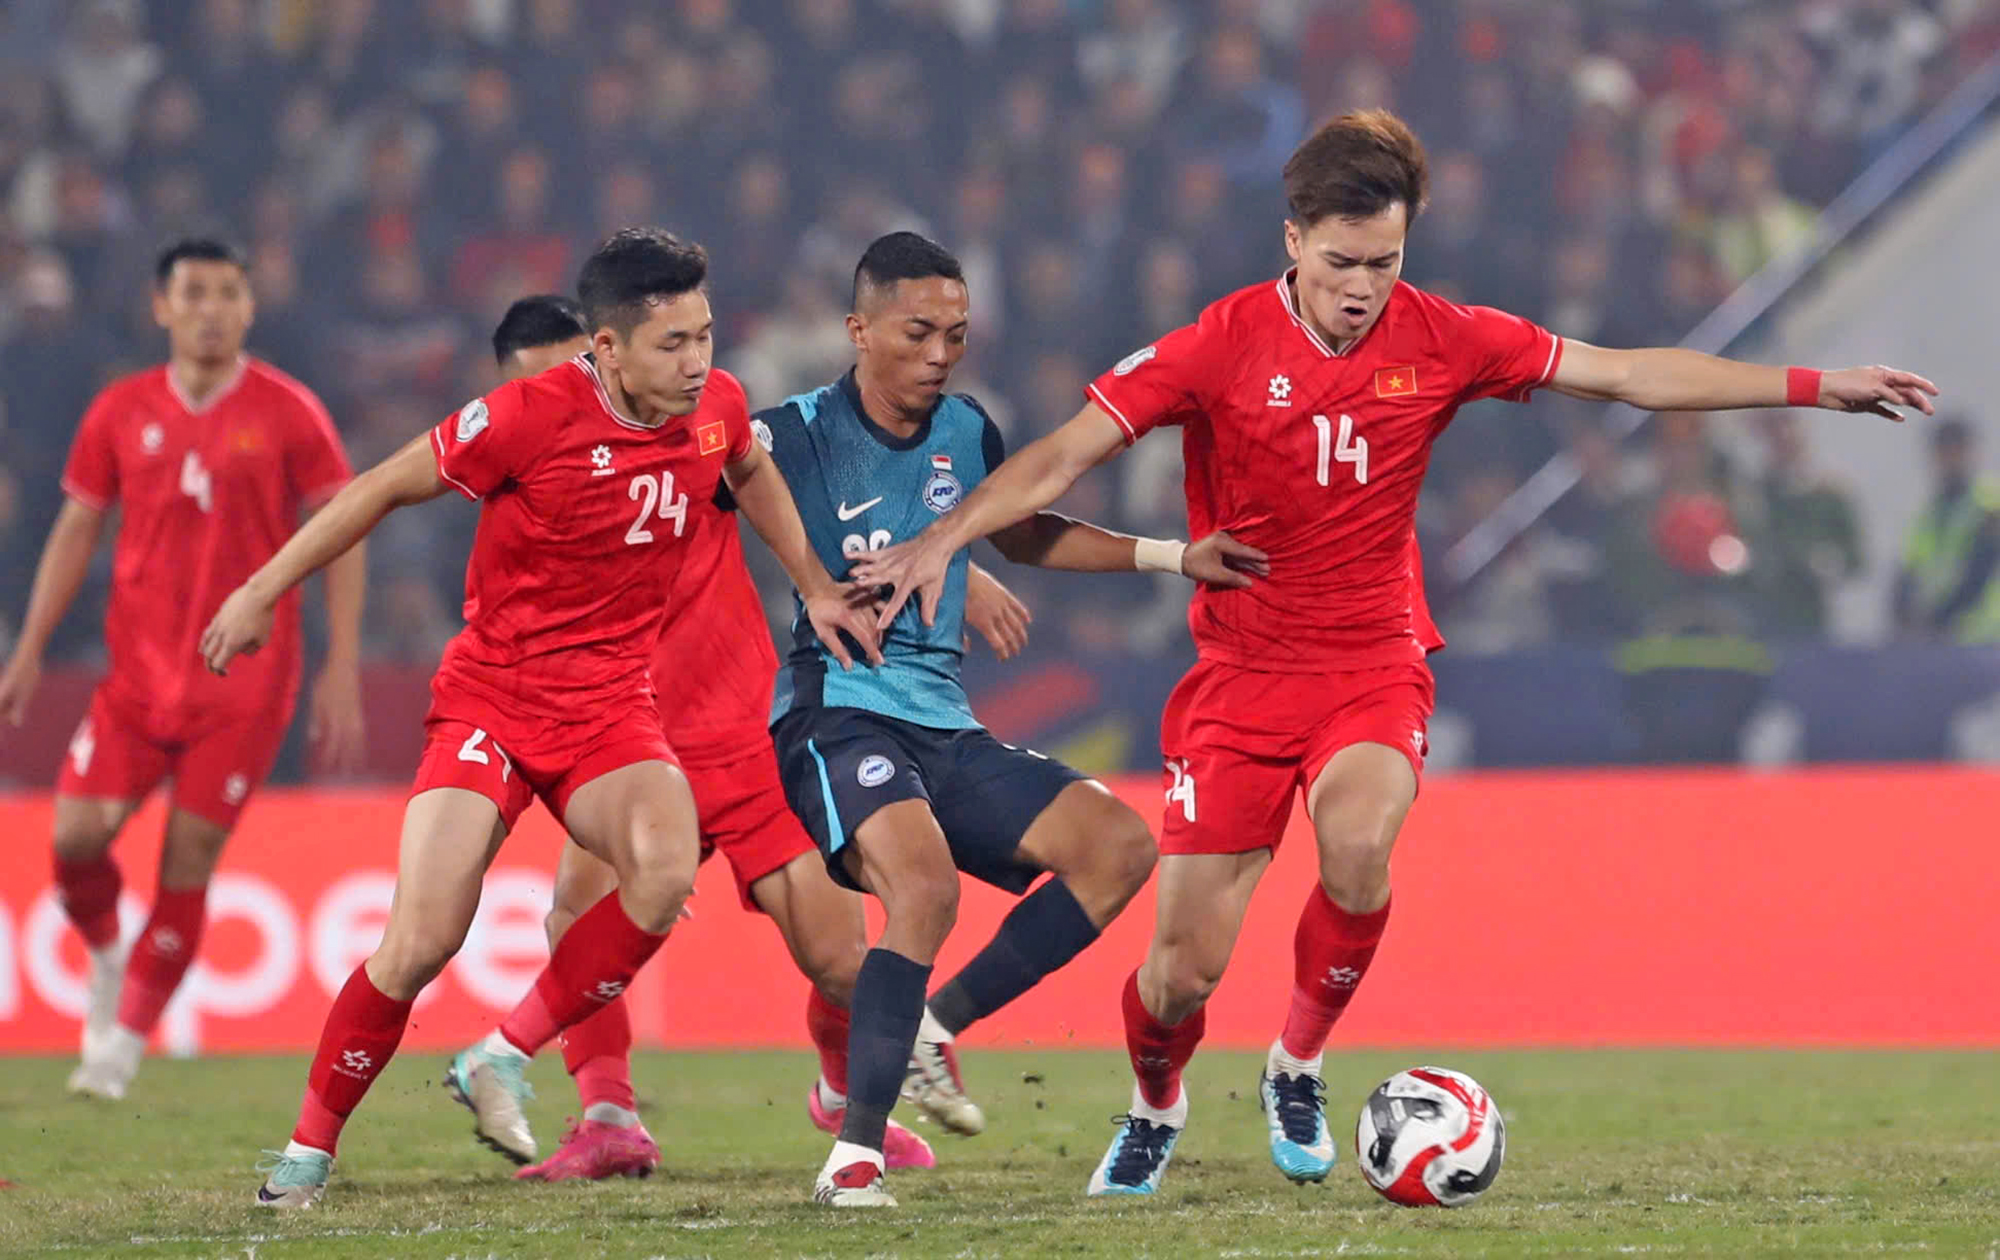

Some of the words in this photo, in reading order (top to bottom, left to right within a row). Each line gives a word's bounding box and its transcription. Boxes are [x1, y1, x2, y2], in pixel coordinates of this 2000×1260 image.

[180, 450, 213, 513] 4
[1312, 414, 1369, 487] 14
[624, 470, 689, 546] 24
